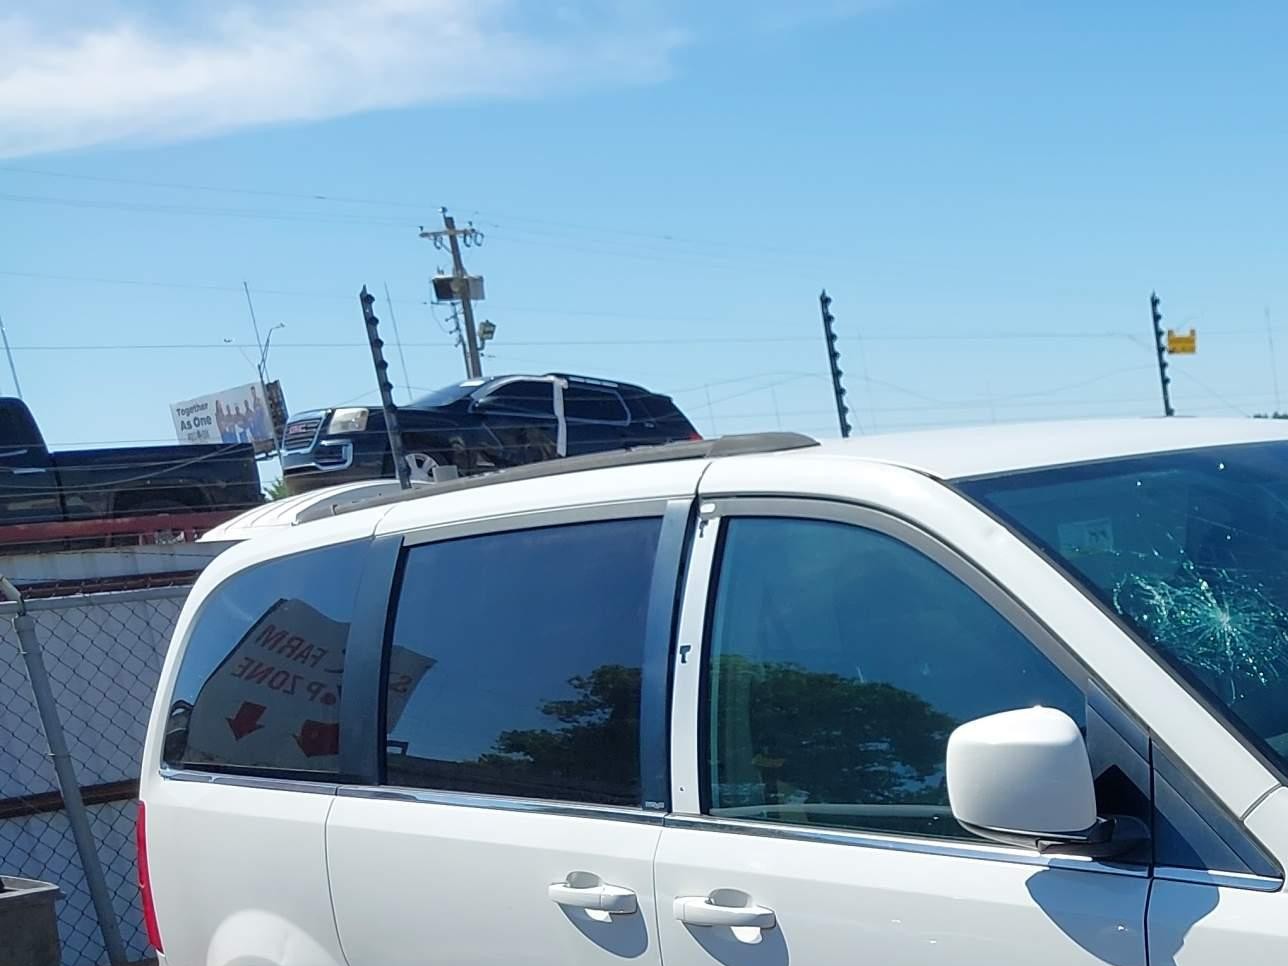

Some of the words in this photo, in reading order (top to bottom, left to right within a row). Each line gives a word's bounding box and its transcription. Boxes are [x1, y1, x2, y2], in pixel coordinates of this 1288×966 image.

[176, 403, 208, 417] Together
[181, 420, 192, 432] As
[193, 415, 212, 428] One
